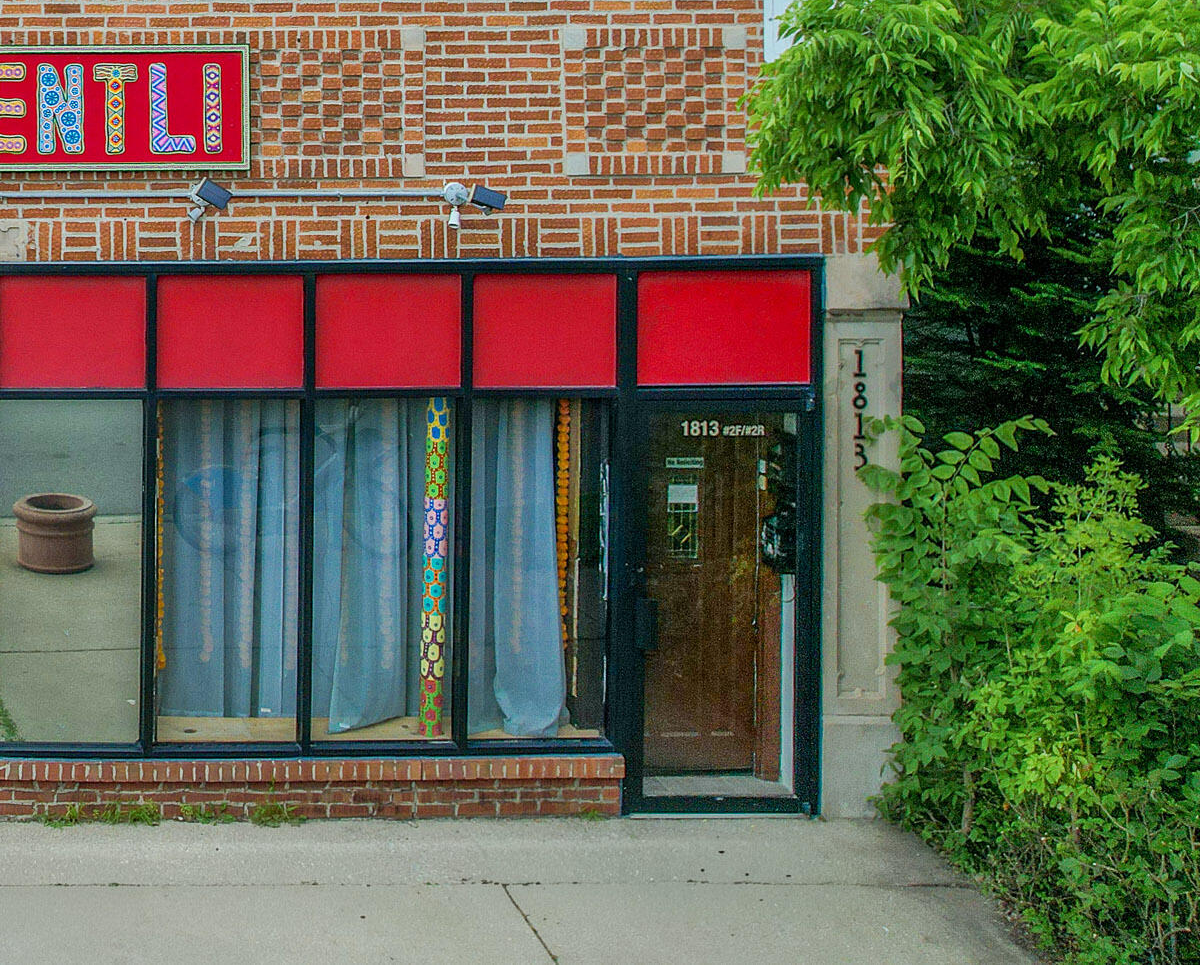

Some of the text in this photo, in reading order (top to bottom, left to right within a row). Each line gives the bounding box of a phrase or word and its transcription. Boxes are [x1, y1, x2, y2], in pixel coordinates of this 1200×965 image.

[681, 420, 765, 436] 1813 #2F/#2R
[852, 349, 868, 471] 1813
